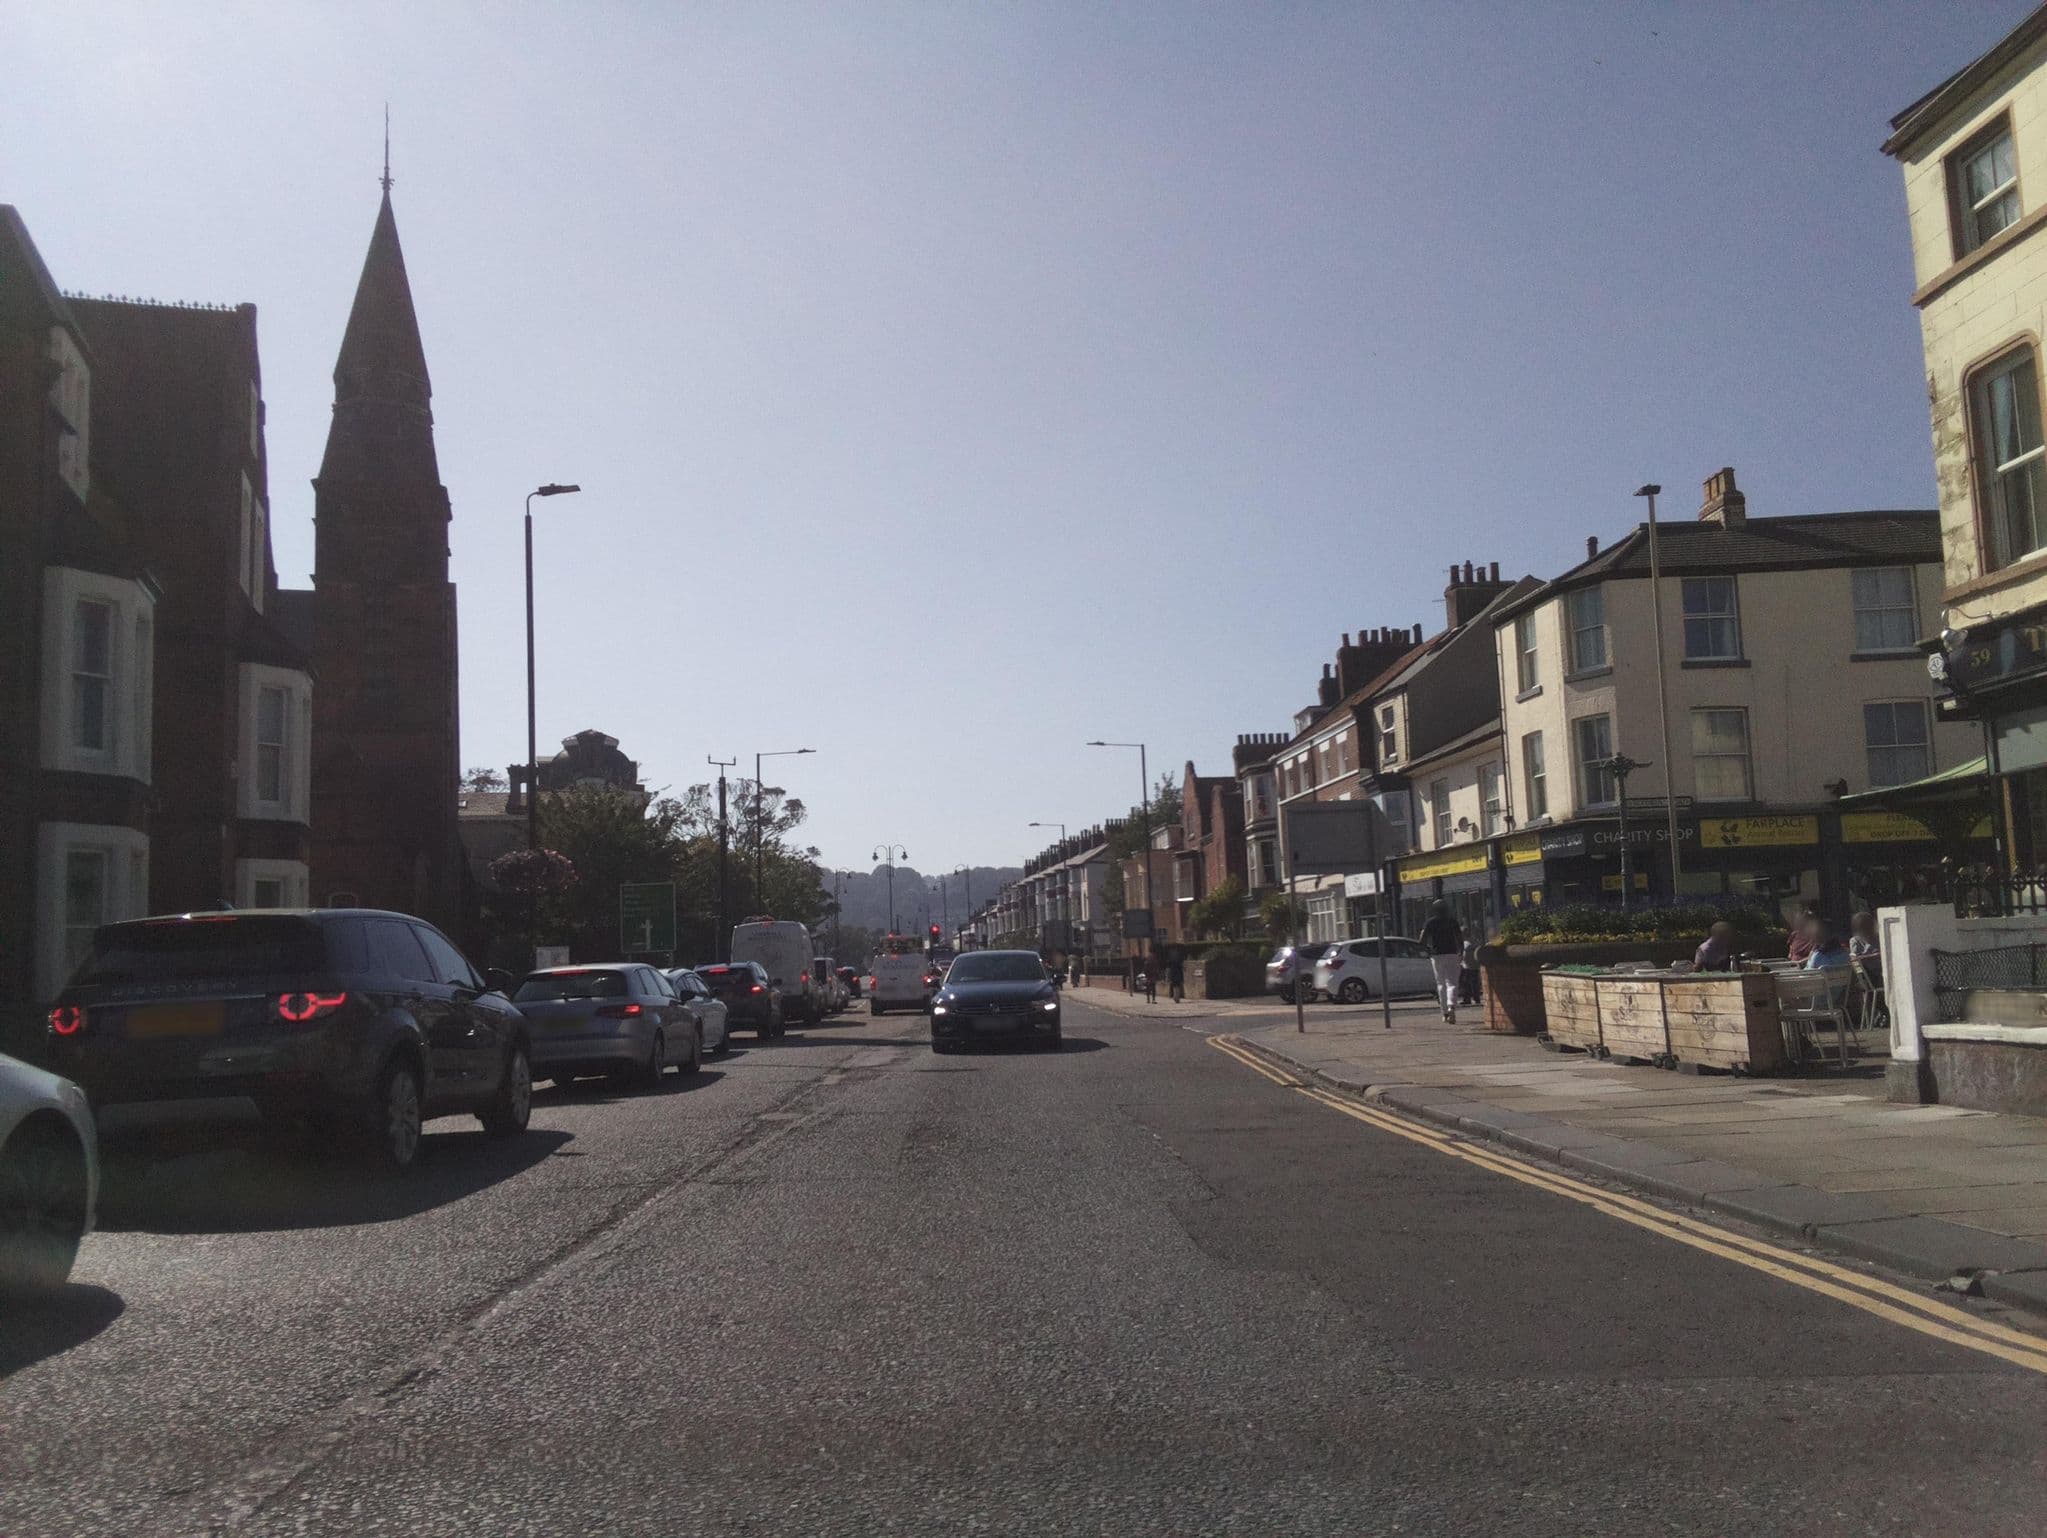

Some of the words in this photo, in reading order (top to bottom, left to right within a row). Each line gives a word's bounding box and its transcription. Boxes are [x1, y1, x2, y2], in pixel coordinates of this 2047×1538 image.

[1970, 648, 1992, 669] 59
[1745, 816, 1806, 829] FARPLACE
[111, 982, 237, 998] DISCOVERY
